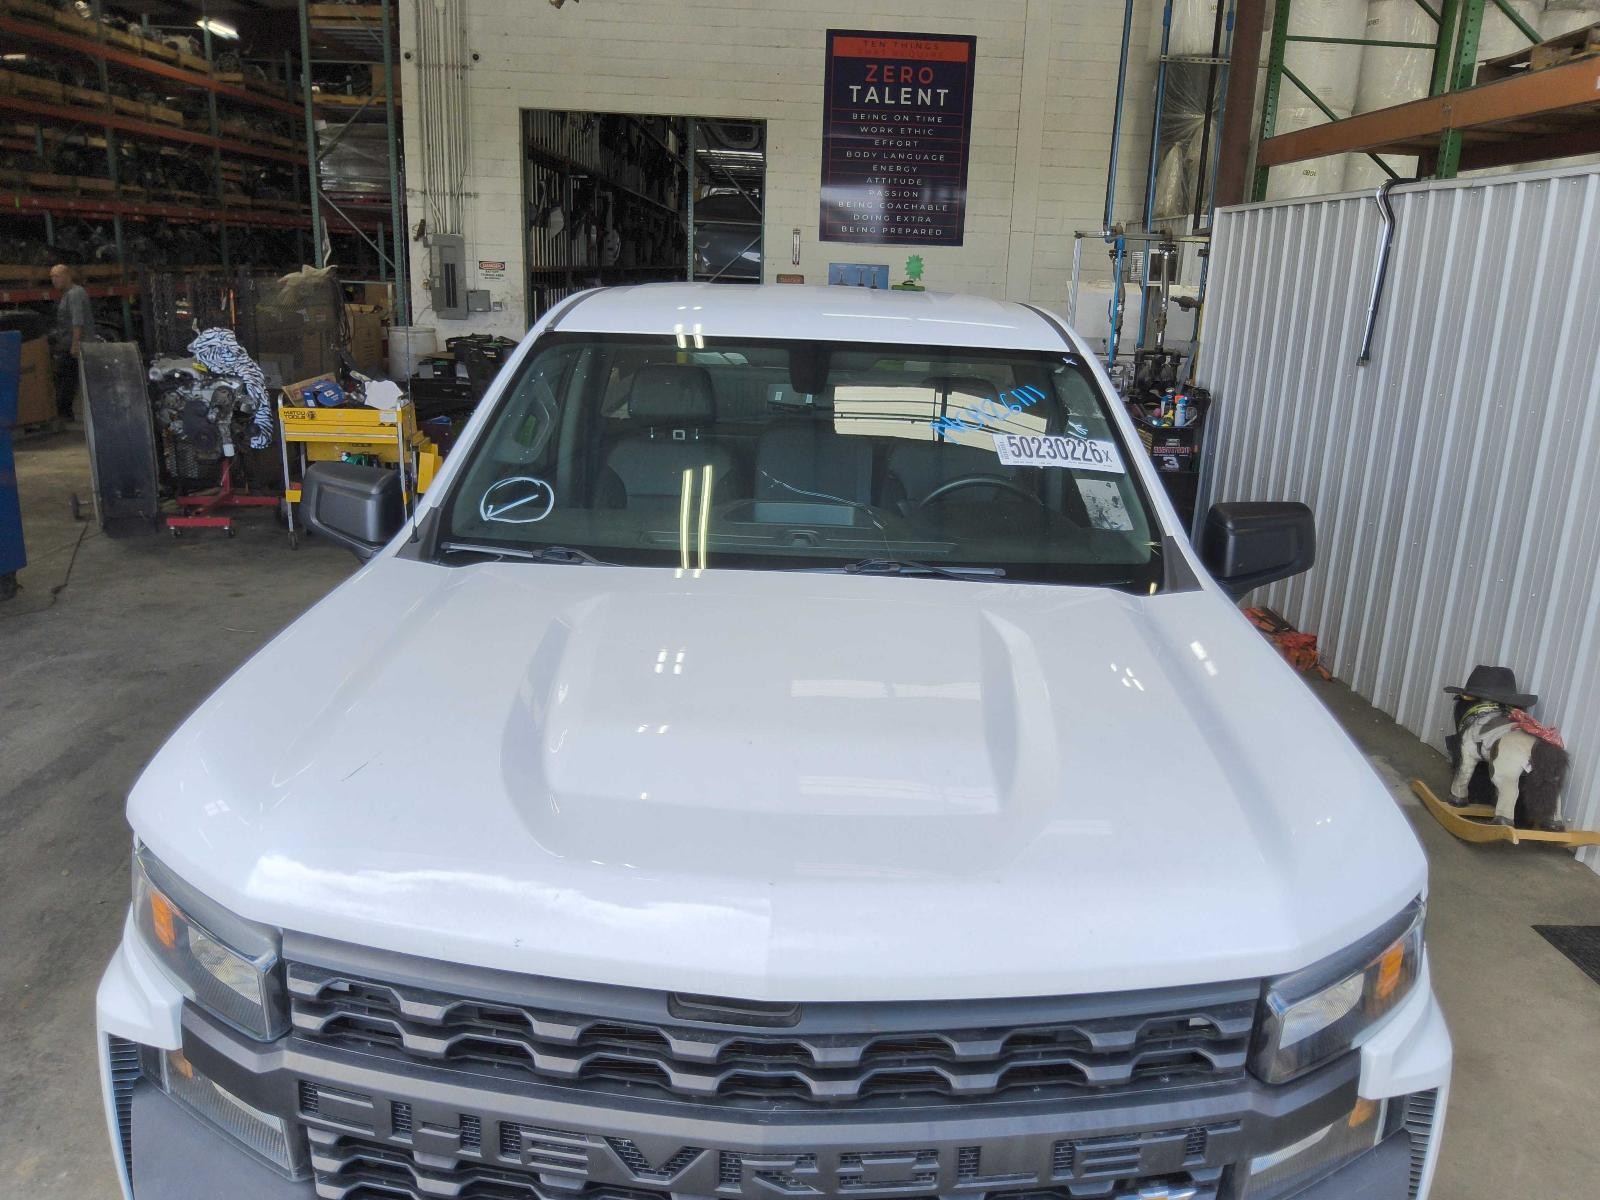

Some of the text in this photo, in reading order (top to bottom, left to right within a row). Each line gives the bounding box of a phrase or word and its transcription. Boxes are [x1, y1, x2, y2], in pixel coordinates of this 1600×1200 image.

[863, 40, 940, 50] TEN THINGS
[864, 64, 935, 85] ZERO
[848, 85, 949, 106] TALENT
[852, 113, 887, 121] BEING
[915, 115, 943, 123] TIME
[859, 126, 934, 136] WORK ETHIC
[874, 139, 920, 147] EFFORT
[883, 152, 945, 161] LANGUAGE
[872, 164, 918, 173] ENERGY
[866, 177, 922, 185] ATTITUDE
[868, 189, 919, 198] PASSION
[838, 201, 949, 211] BEING COACHABLE
[853, 213, 932, 223] DOING EXTRA
[841, 225, 942, 236] BEING PREPARED
[1006, 435, 1103, 464] 50230226
[298, 1080, 1243, 1194] CHEVROLET
